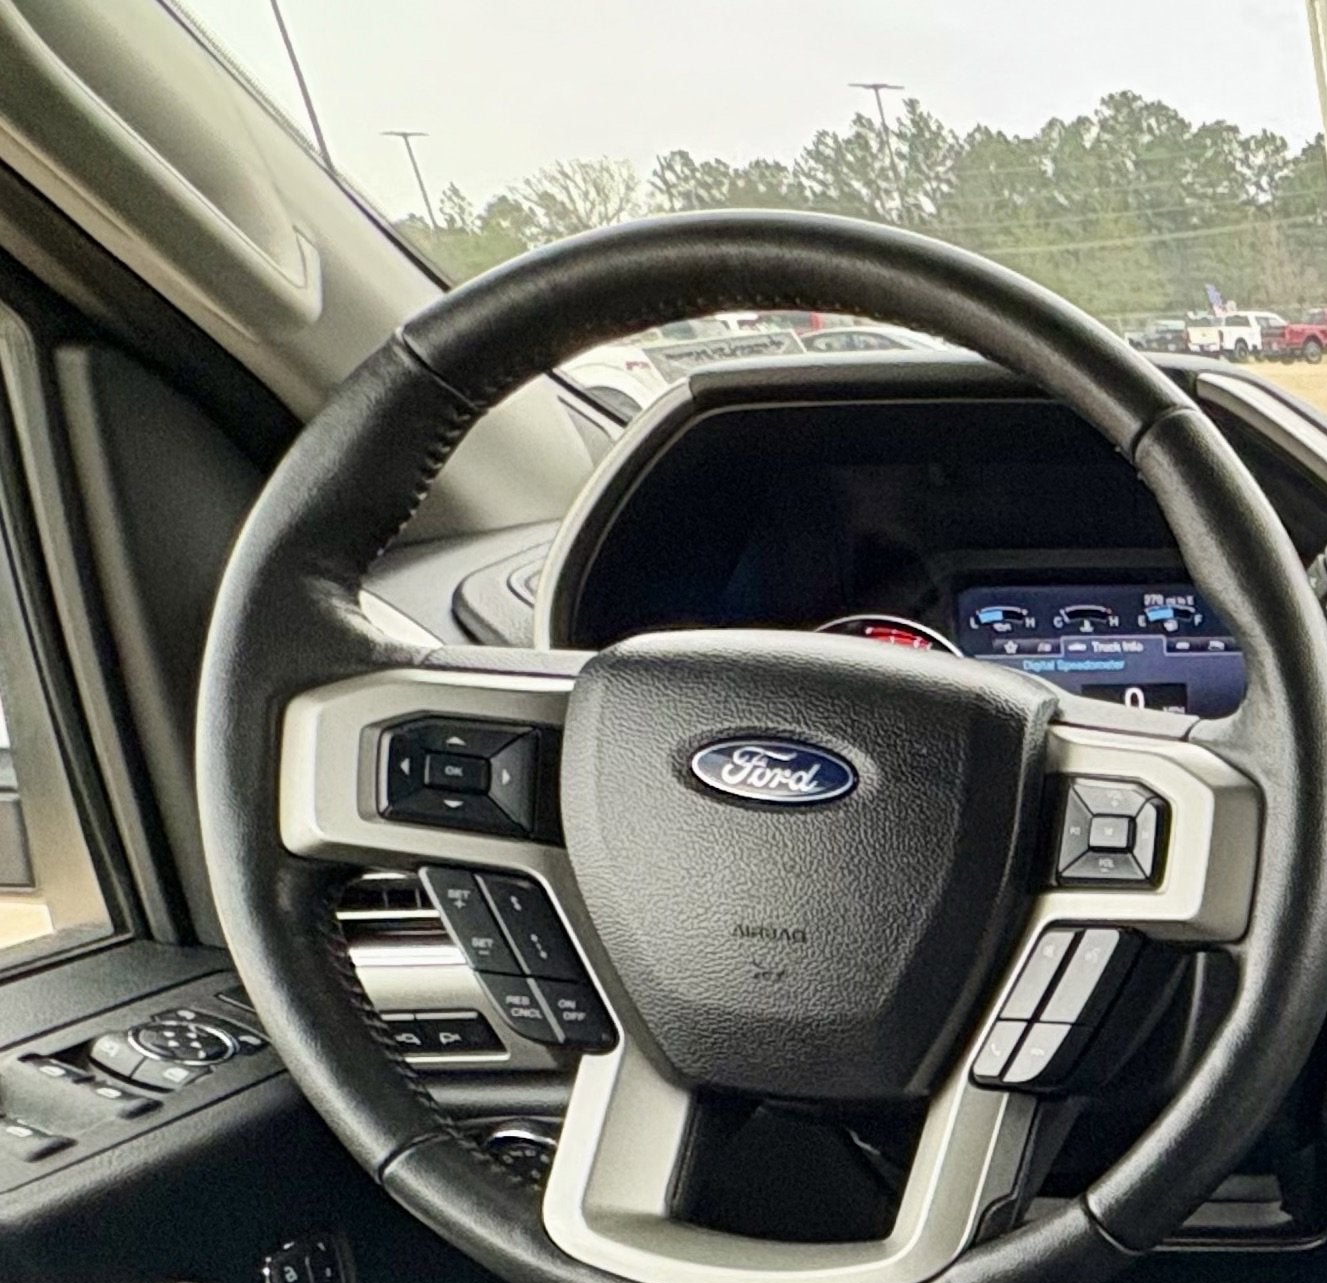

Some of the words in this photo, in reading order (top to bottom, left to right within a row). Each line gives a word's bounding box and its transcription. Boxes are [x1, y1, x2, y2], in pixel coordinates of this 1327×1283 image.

[1091, 641, 1122, 652] Truck
[1123, 640, 1144, 652] Info
[1023, 660, 1056, 672] Digital
[1057, 660, 1125, 671] Speedometer
[444, 765, 464, 777] OK
[720, 746, 819, 794] Ford
[448, 889, 471, 899] SET
[471, 937, 494, 948] SET
[558, 1000, 577, 1010] ON
[511, 1008, 543, 1020] CNCL
[562, 1012, 586, 1021] OFF
